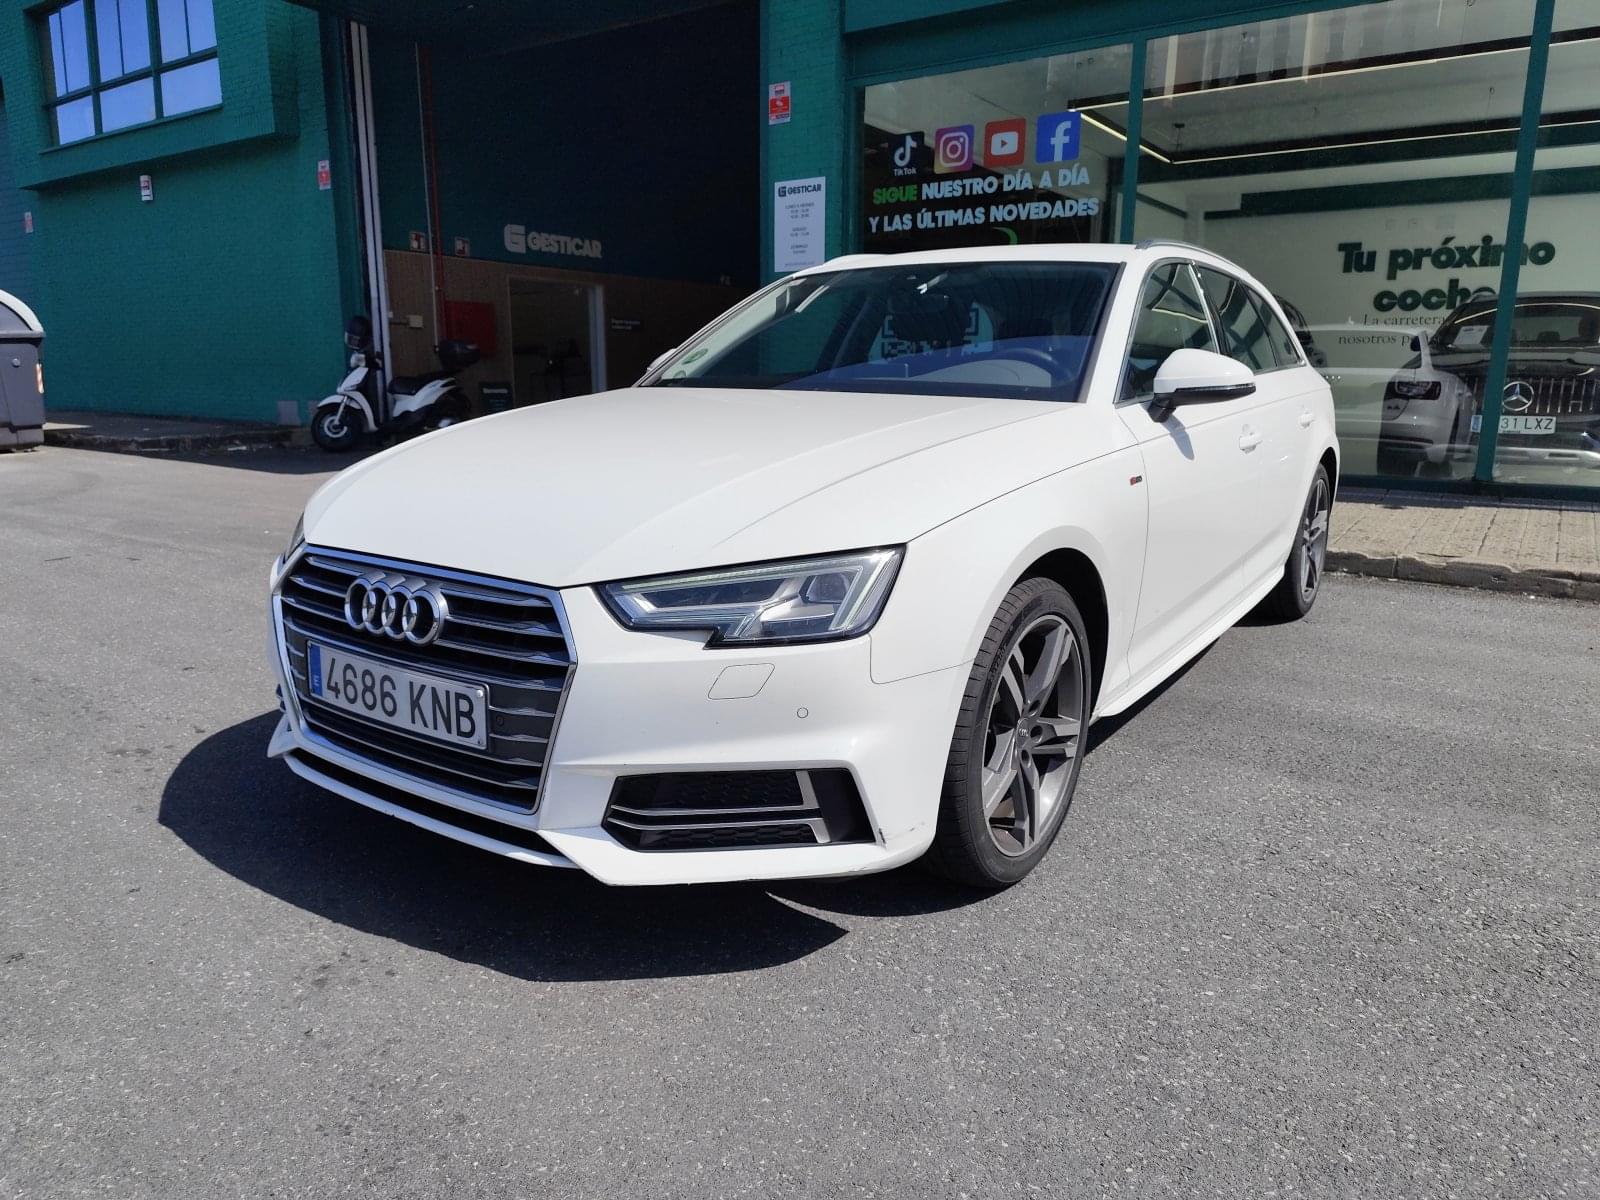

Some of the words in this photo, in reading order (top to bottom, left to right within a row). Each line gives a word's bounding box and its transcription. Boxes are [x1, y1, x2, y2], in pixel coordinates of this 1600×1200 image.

[786, 183, 822, 195] GESTICAR
[873, 184, 918, 204] SIGUE
[922, 176, 999, 200] NUESTRO
[1003, 167, 1034, 191] DÍA
[1039, 170, 1053, 188] A
[1058, 163, 1090, 186] DÍA
[869, 216, 881, 233] Y
[884, 212, 913, 232] LAS
[917, 206, 985, 230] ÚLTIMAS
[990, 198, 1099, 222] NOVEDADES
[528, 231, 603, 258] GESTICAR
[1338, 242, 1377, 273] Tu
[1373, 278, 1496, 312] coch
[1338, 335, 1397, 345] nosotros
[1524, 418, 1553, 430] LXZ
[327, 658, 397, 717] 4686
[409, 681, 476, 739] KNB
